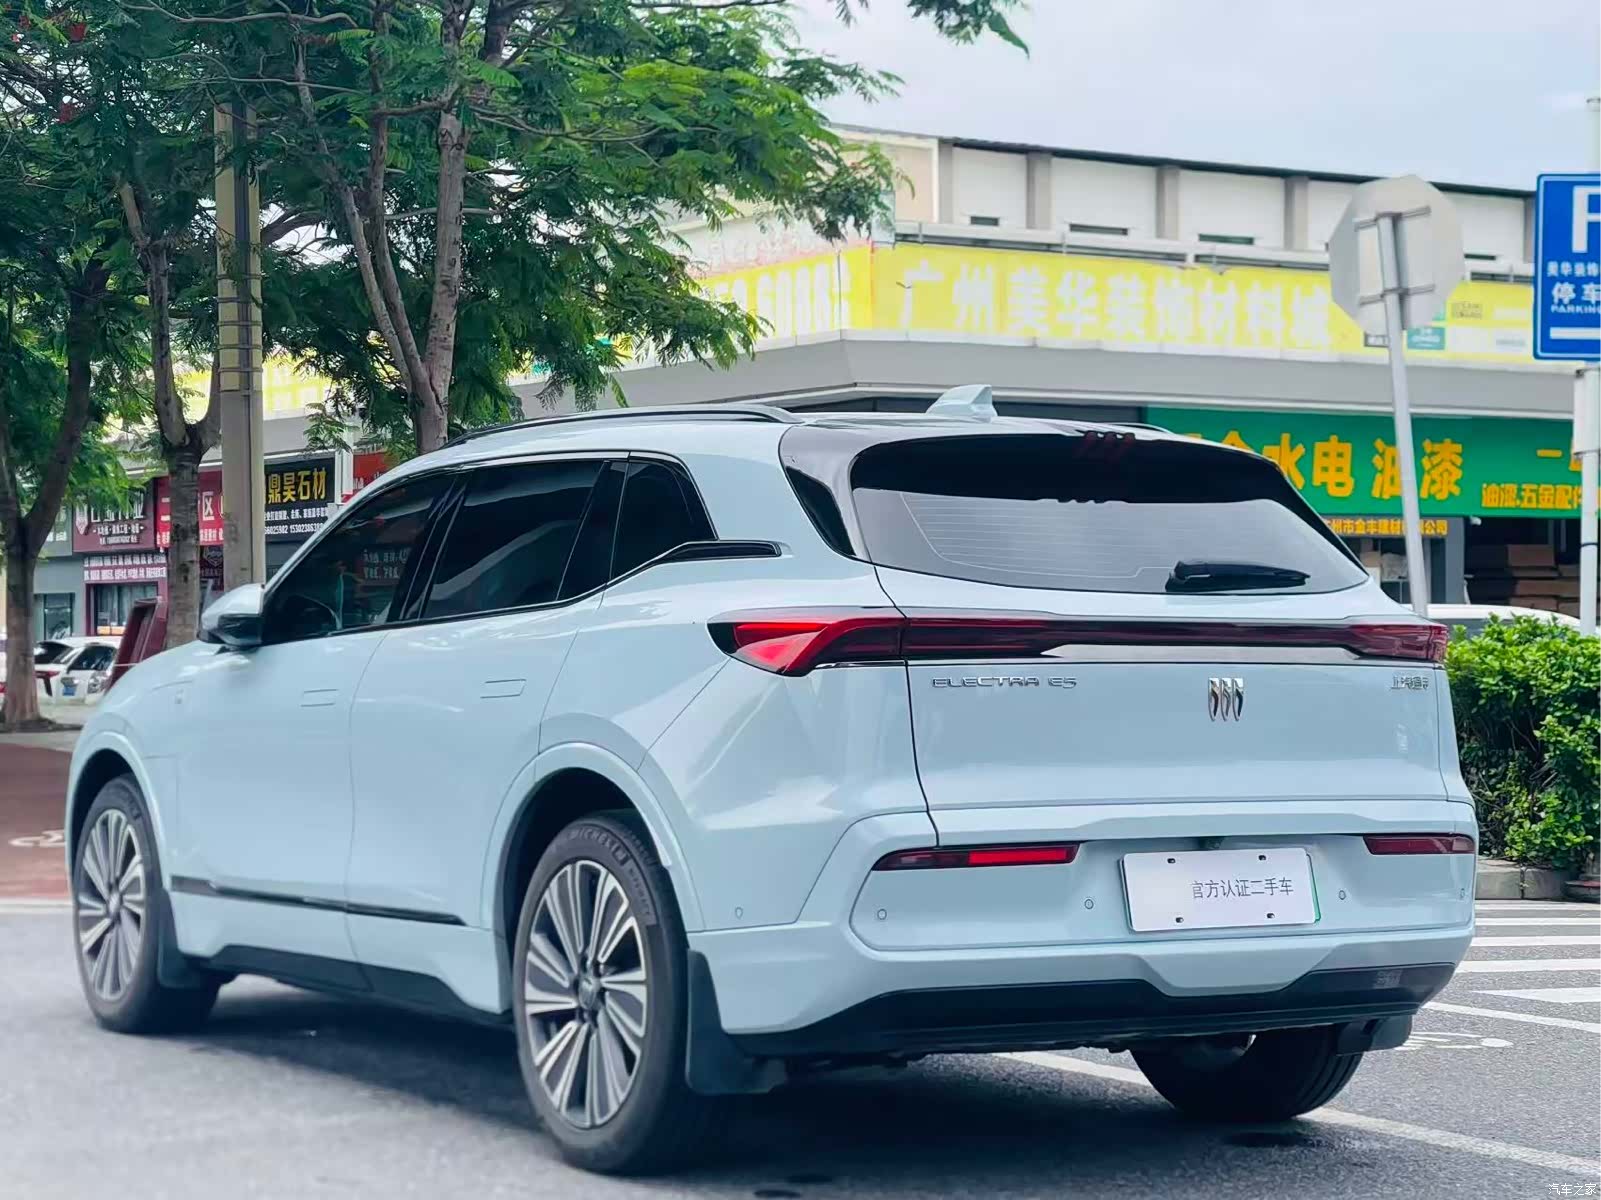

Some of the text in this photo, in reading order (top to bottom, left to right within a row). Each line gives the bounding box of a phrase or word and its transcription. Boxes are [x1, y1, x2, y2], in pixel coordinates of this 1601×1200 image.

[1372, 438, 1463, 500] 油漆
[268, 468, 327, 504] 鼎昊石材
[932, 676, 1077, 689] ELECTRA E5
[1191, 876, 1294, 899] 官方认证二手车
